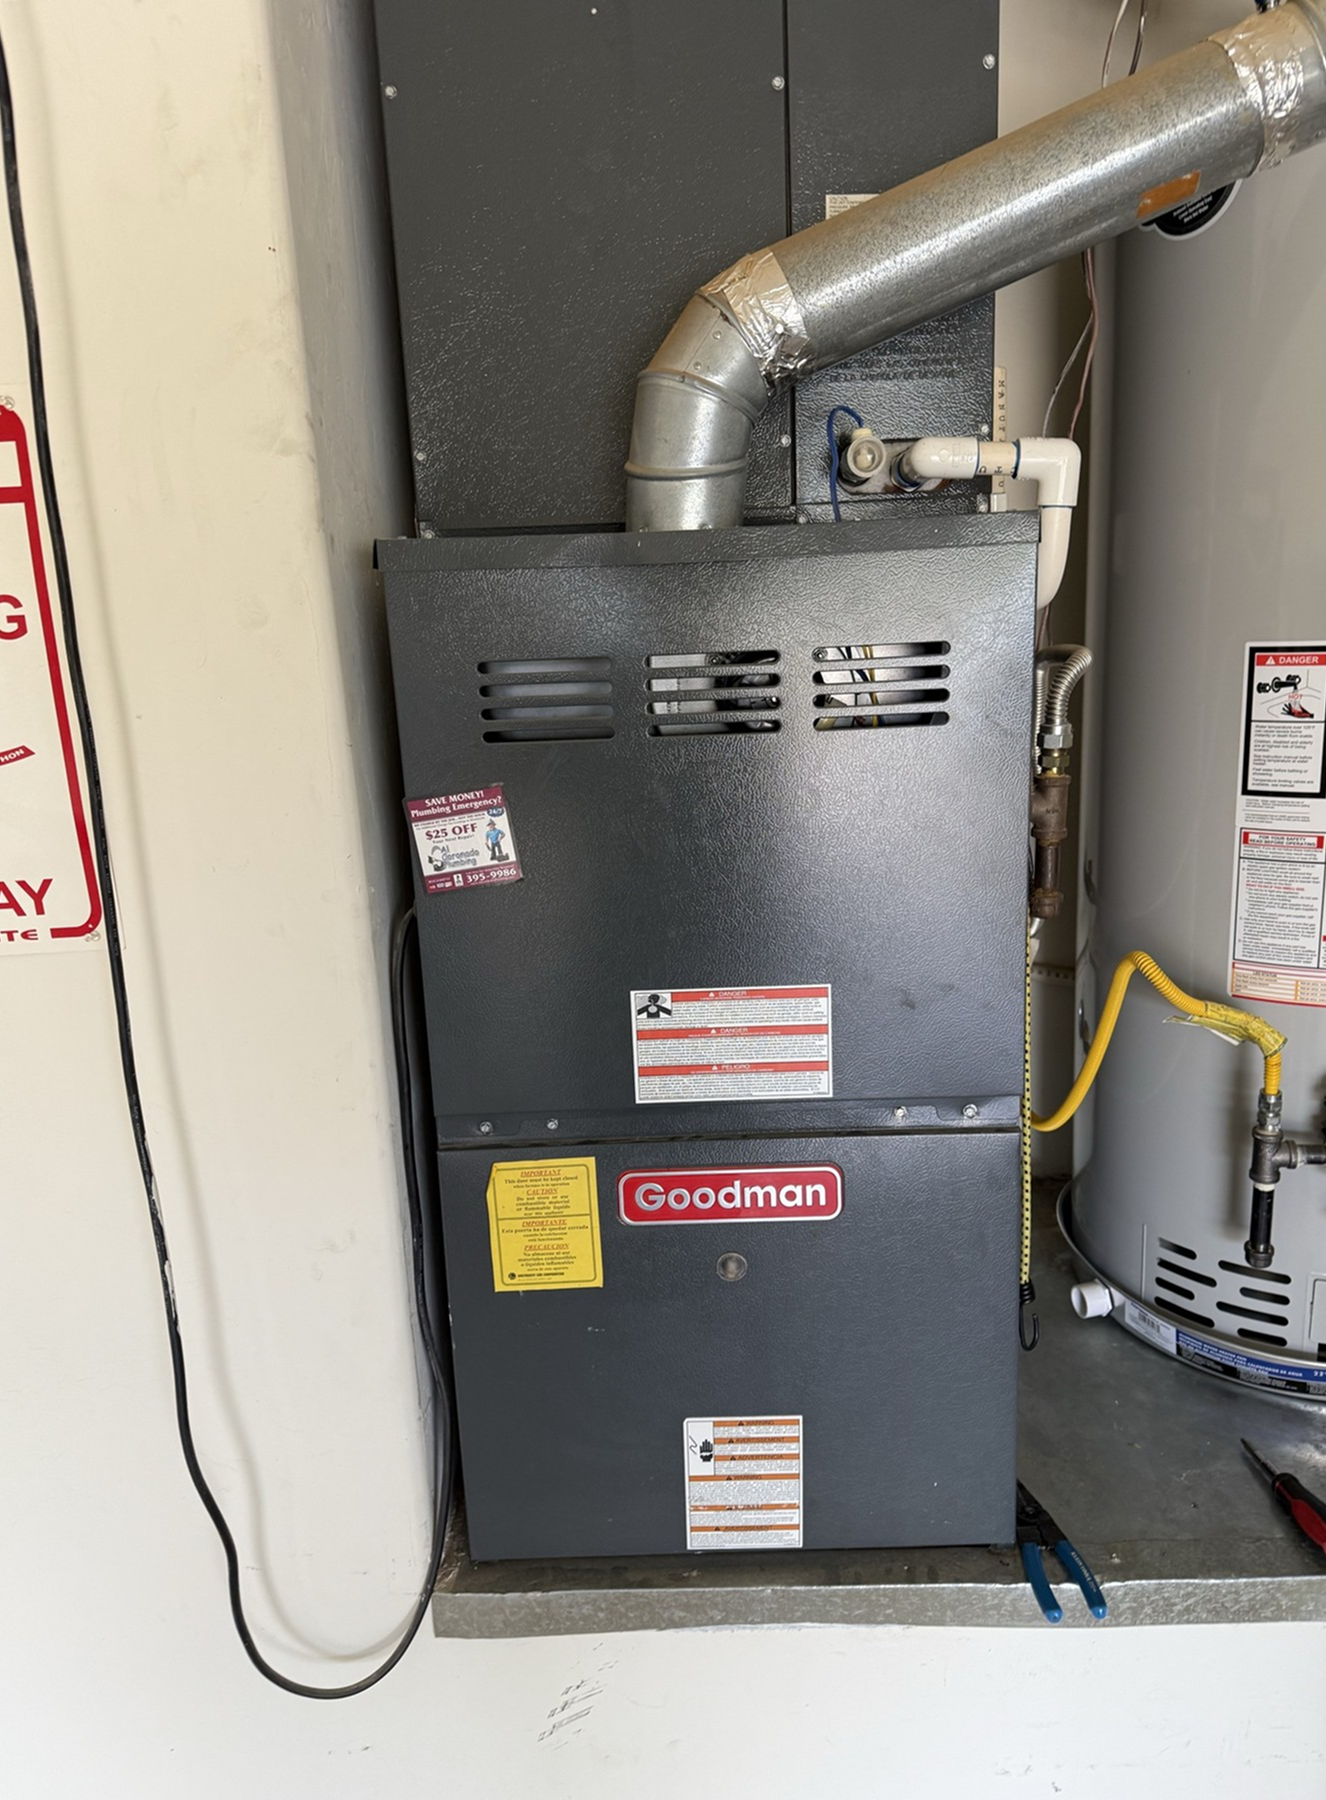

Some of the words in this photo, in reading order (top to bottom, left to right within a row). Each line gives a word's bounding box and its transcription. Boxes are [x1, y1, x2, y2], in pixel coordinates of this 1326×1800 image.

[1279, 656, 1320, 665] DANGER
[425, 795, 446, 806] SAVE
[449, 790, 484, 803] MONEY!
[410, 805, 451, 818] Plumbing
[452, 796, 501, 810] Emergency?
[426, 828, 448, 840] $25
[452, 823, 478, 836] OFF
[467, 868, 517, 883] 395-9986
[634, 1180, 826, 1211] Goodman
